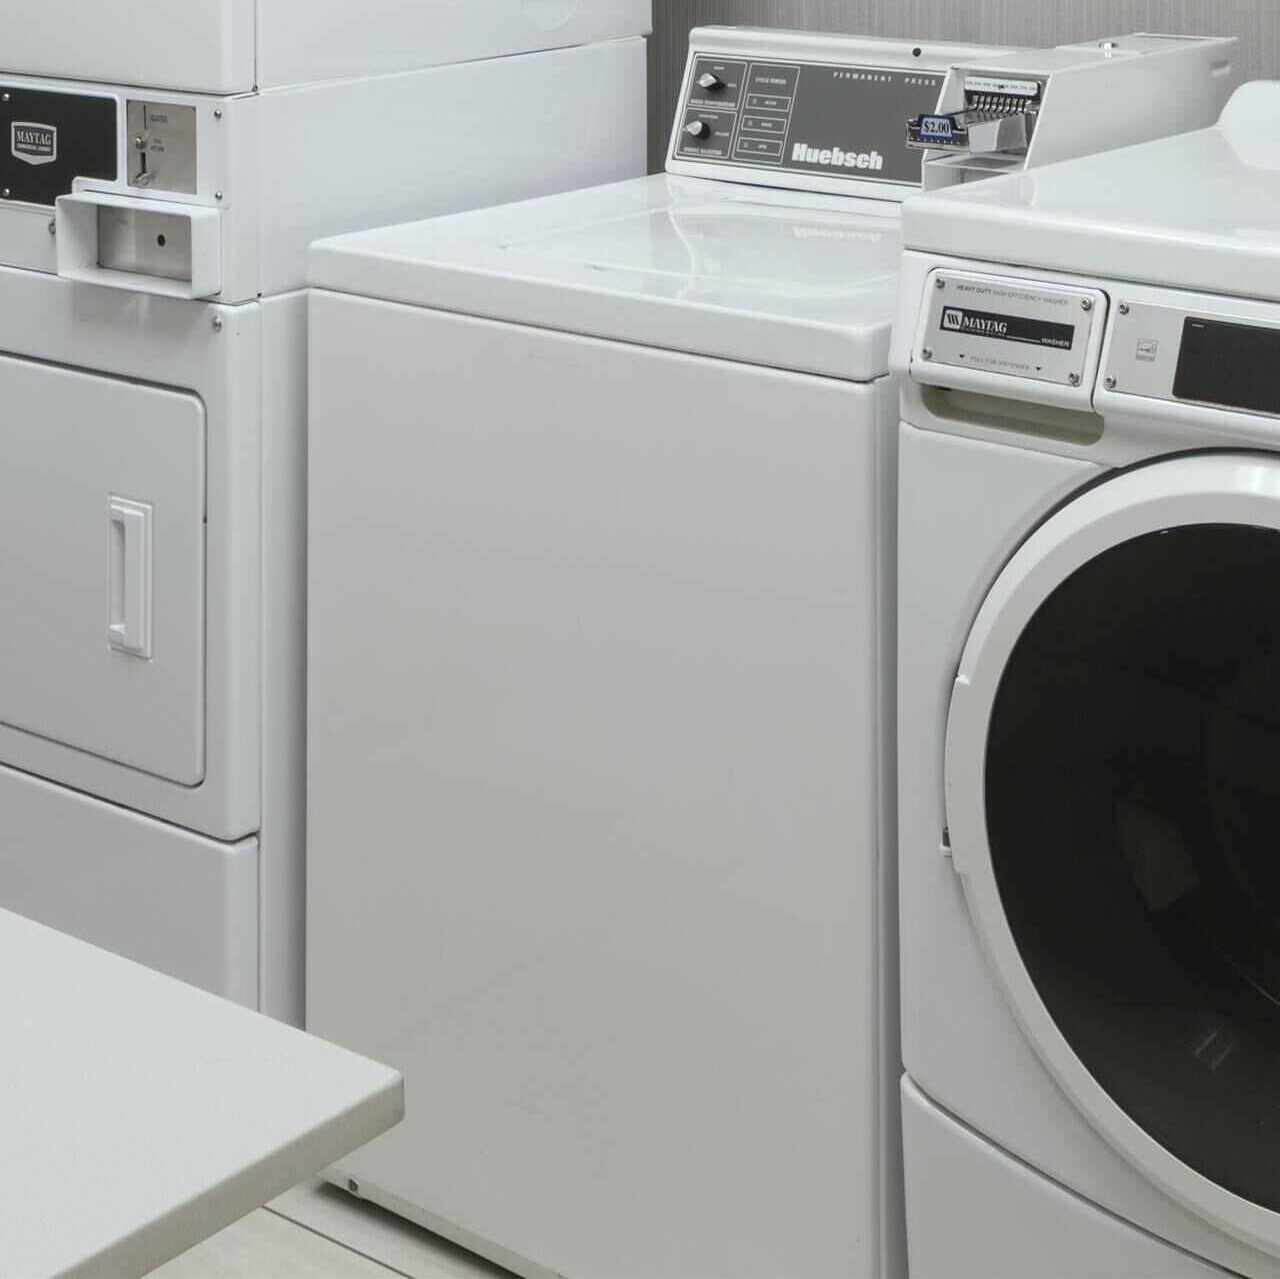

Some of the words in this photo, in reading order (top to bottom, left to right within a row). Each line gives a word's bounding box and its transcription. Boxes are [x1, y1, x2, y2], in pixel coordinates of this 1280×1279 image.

[832, 71, 892, 83] PERMANENT
[904, 77, 937, 87] PRESS
[923, 120, 950, 134] $2.00
[16, 129, 52, 146] MAYTAG
[791, 142, 884, 171] Huebsch
[956, 284, 976, 293] HEAVY
[975, 286, 993, 295] DUTY
[1008, 291, 1042, 303] EFFICIENCY
[1043, 296, 1069, 306] WASHER
[962, 316, 1008, 334] MAYTAG
[1040, 337, 1071, 348] WASHER
